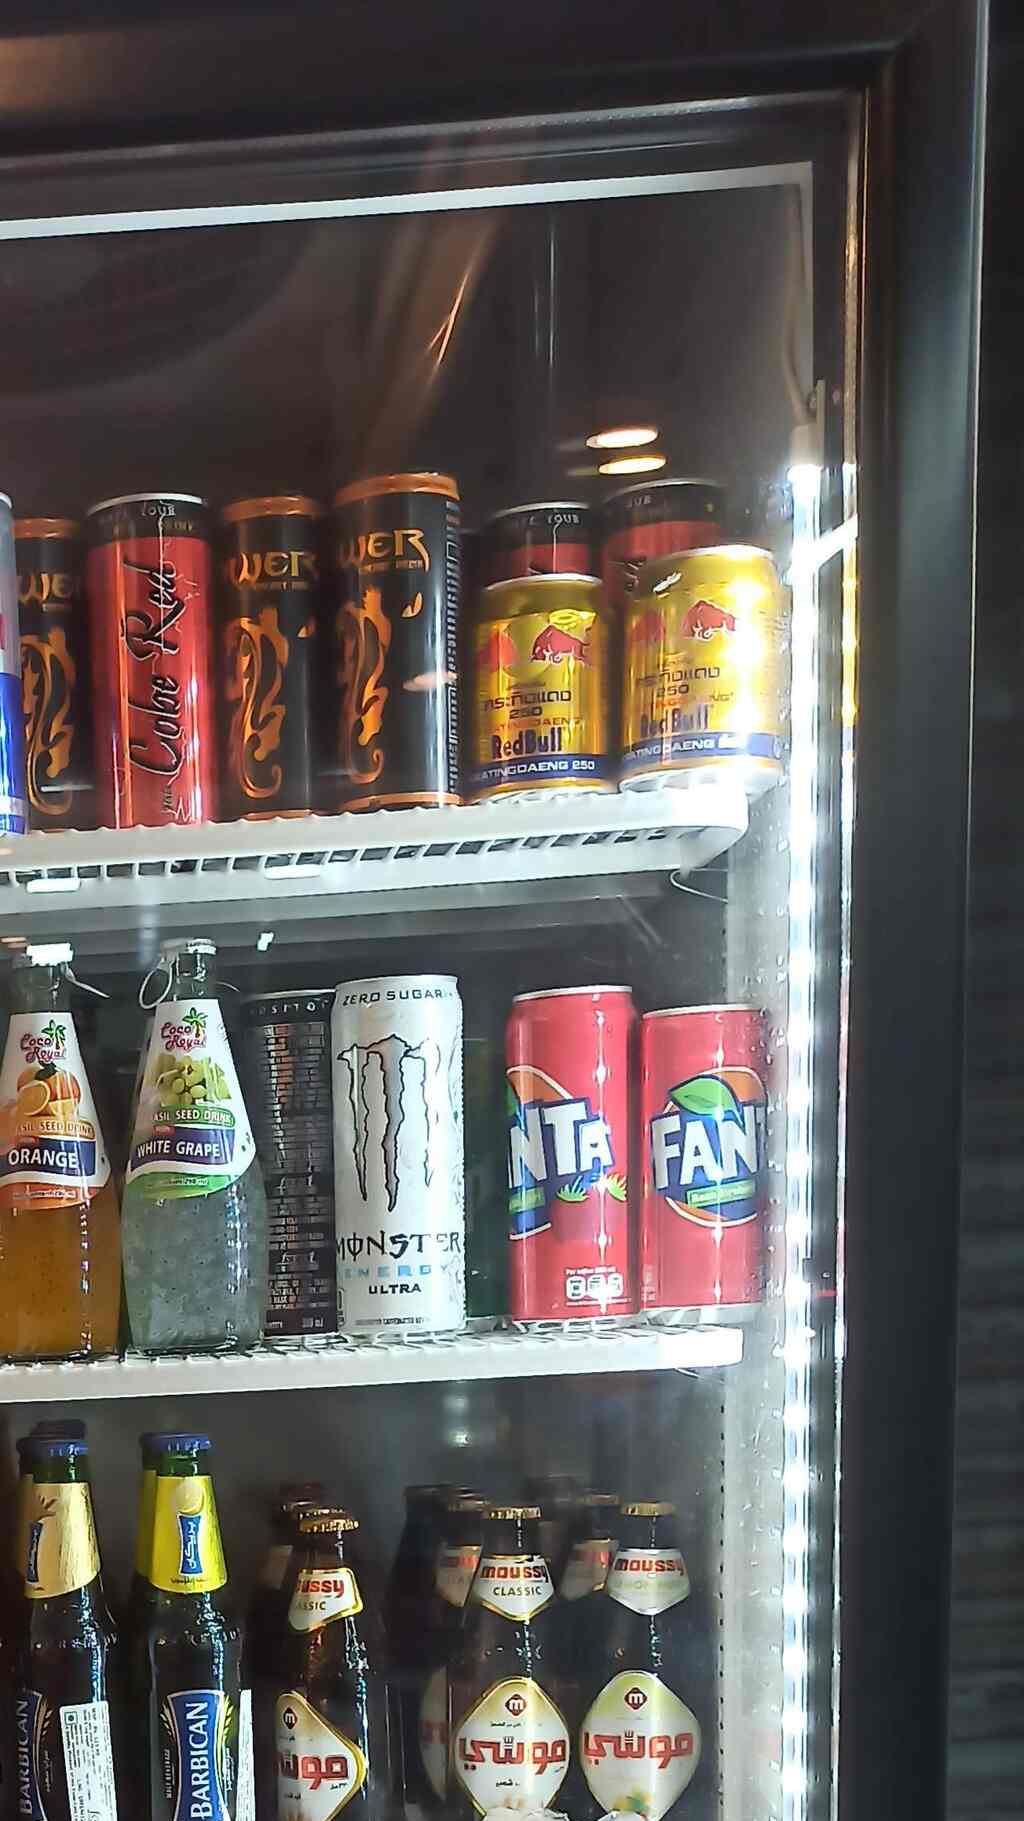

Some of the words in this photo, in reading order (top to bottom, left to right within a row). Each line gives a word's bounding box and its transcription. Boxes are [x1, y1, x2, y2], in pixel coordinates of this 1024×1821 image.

[342, 992, 381, 1007] ZERO
[176, 1108, 201, 1121] SEED
[204, 1108, 233, 1125] DRINK
[40, 1119, 64, 1133] SEED
[137, 1139, 172, 1160] WHITE
[176, 1140, 222, 1158] GRAPE
[8, 1148, 80, 1169] ORANGE
[368, 1283, 422, 1295] ULTRA
[480, 1564, 550, 1584] moussy
[492, 1586, 542, 1597] CLASSIC
[186, 1702, 214, 1820] BARBICAN
